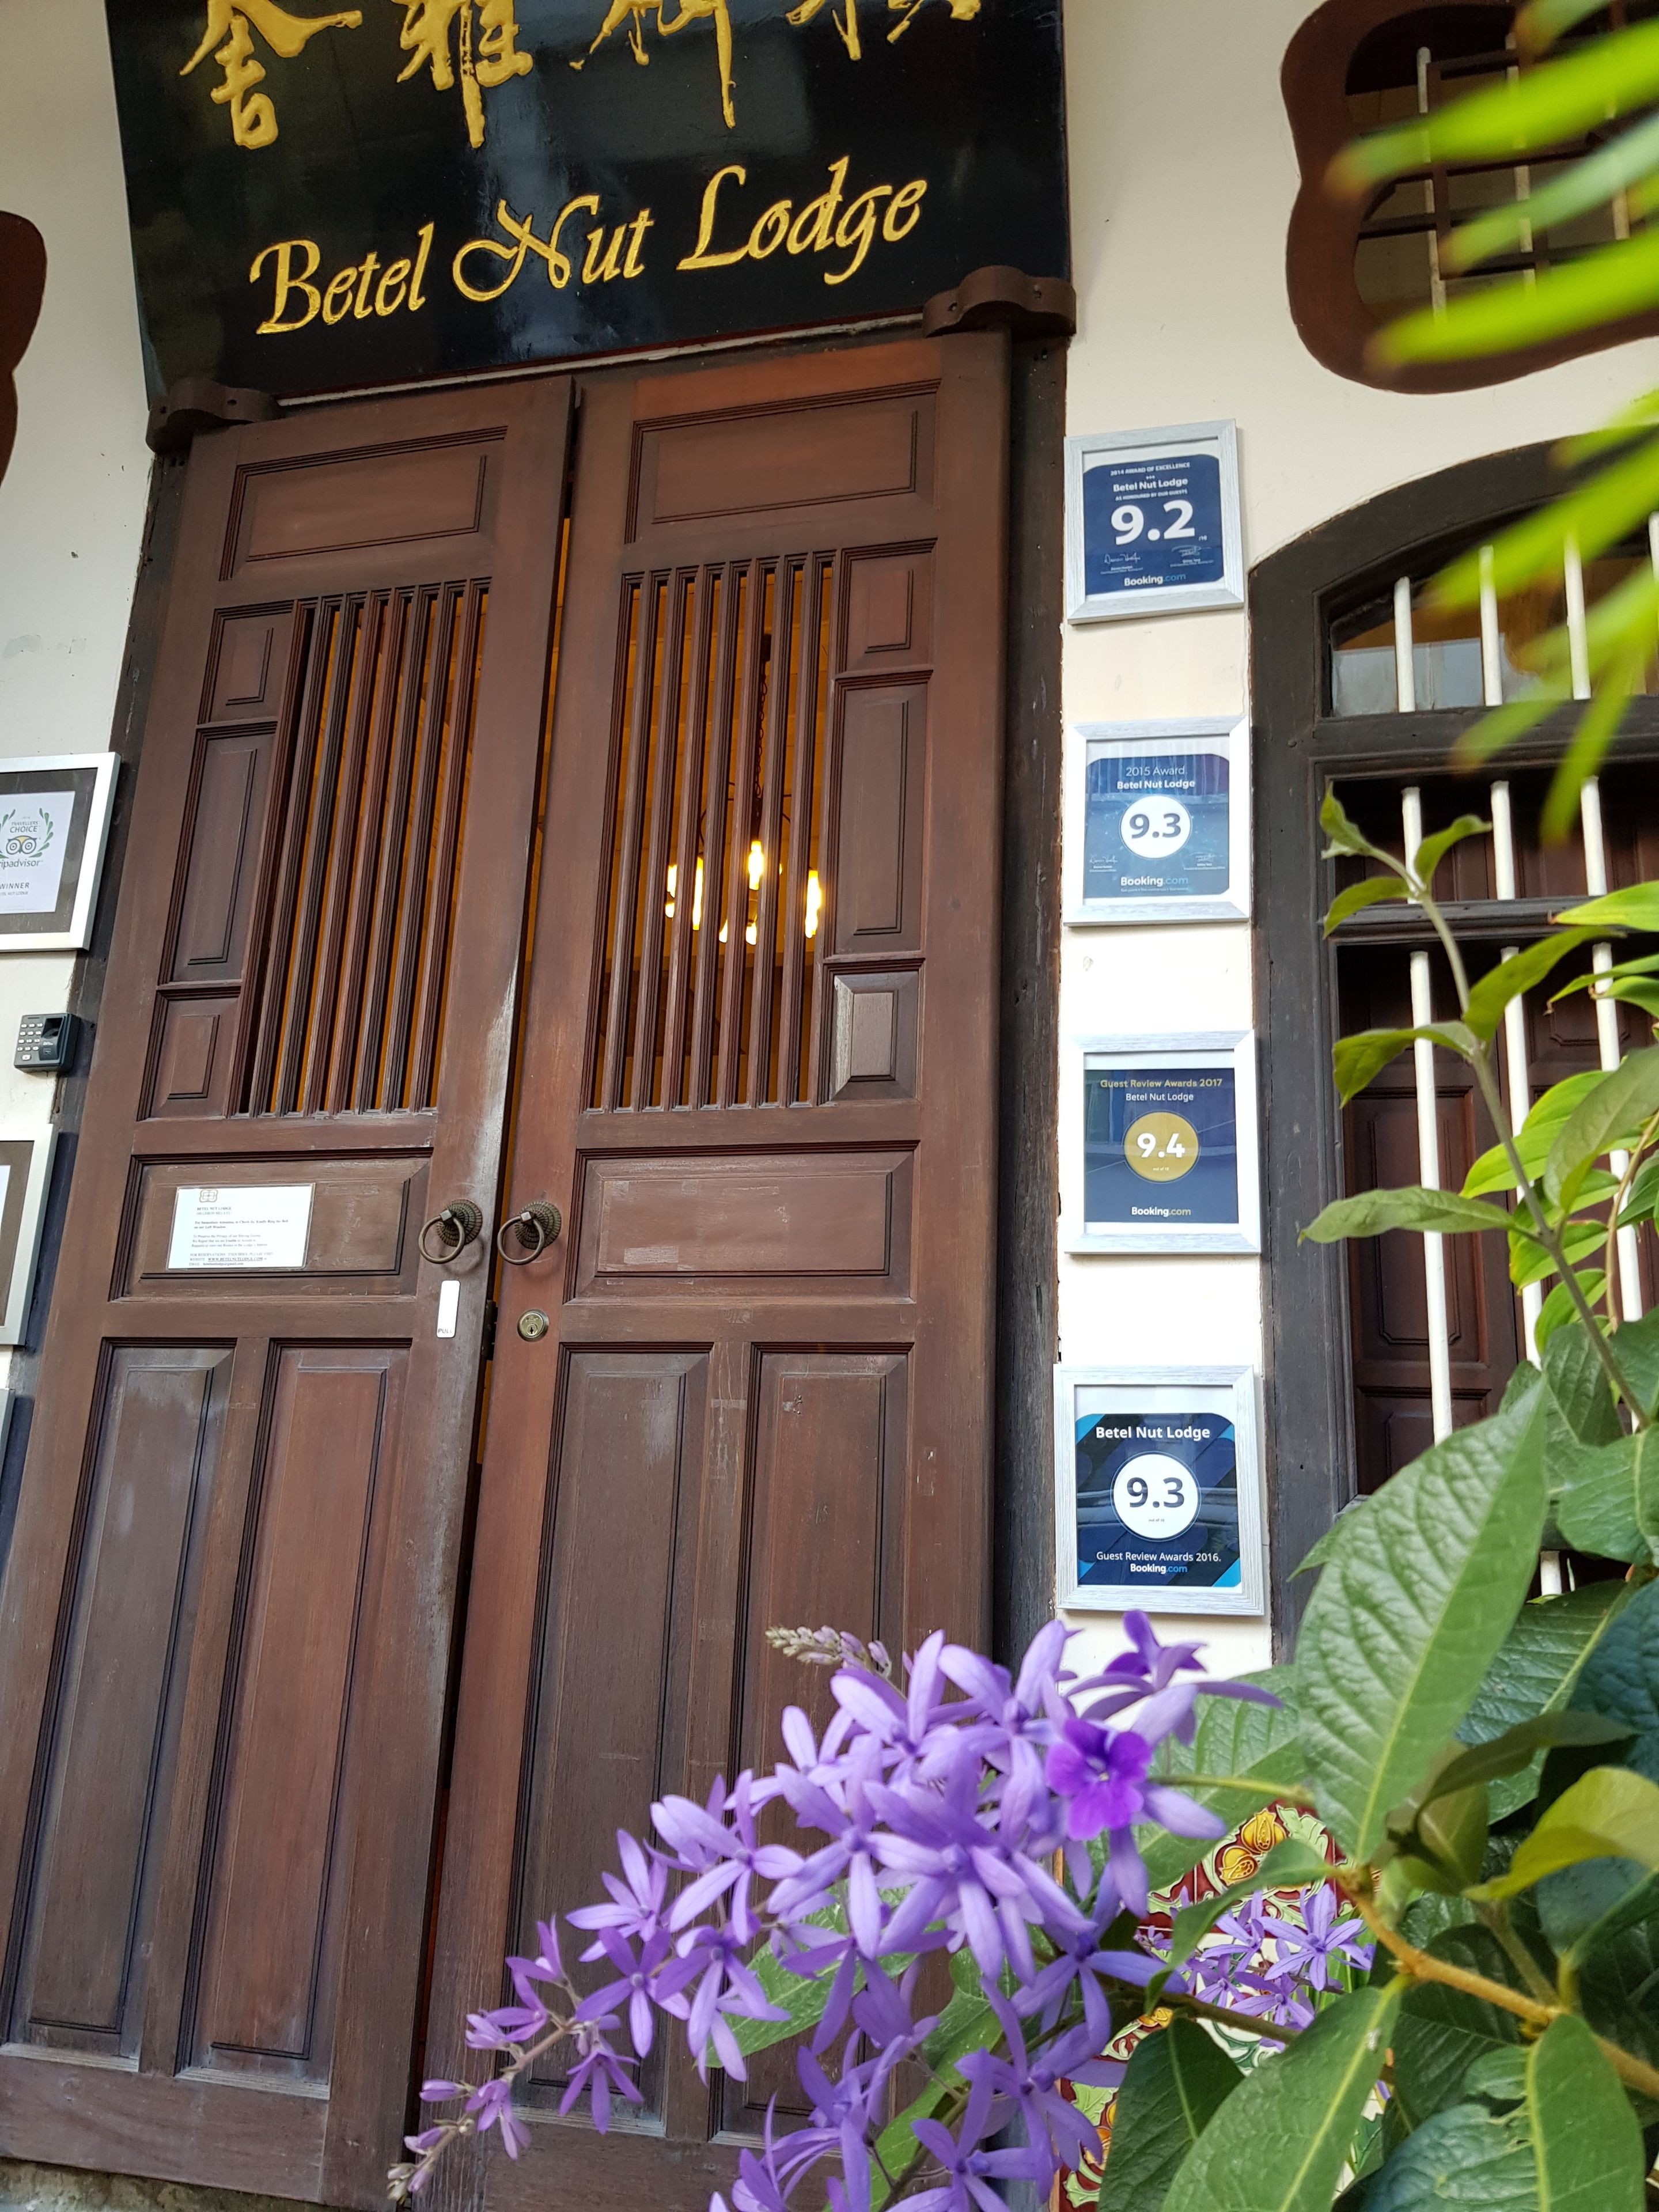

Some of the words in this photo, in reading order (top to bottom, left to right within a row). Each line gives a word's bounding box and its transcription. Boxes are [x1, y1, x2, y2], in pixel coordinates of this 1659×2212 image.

[249, 222, 434, 335] Betel
[453, 194, 654, 302] Nut
[676, 155, 927, 285] Lodge
[1156, 462, 1190, 471] EXCELLENCE
[1113, 482, 1137, 492] Betel
[1139, 480, 1157, 490] Nut
[1158, 478, 1188, 488] Lodge
[1111, 499, 1195, 546] 9.2
[1124, 574, 1186, 586] Booking.com
[1126, 767, 1150, 777] 2015
[1117, 781, 1142, 790] Betel
[1144, 781, 1162, 789] Nut
[1164, 779, 1195, 789] Lodge
[1129, 813, 1181, 839] 9.3
[1120, 876, 1188, 887] Booking.com
[1100, 1080, 1128, 1088] Guest
[1130, 1080, 1162, 1088] Review
[1164, 1079, 1197, 1088] Awards
[1199, 1078, 1222, 1087] 2017
[1168, 1092, 1194, 1103] Lodge
[1137, 1132, 1186, 1158] 9.4
[1131, 1206, 1191, 1217] Booking.com
[1096, 1426, 1132, 1438] Betel
[1136, 1426, 1162, 1438] Nut
[1166, 1426, 1210, 1441] Lodge
[1127, 1477, 1185, 1508] 9.3
[1096, 1551, 1123, 1560] Guest
[1126, 1551, 1157, 1561] Review
[1159, 1552, 1194, 1562] Awards
[1130, 1563, 1188, 1574] Booking.com
